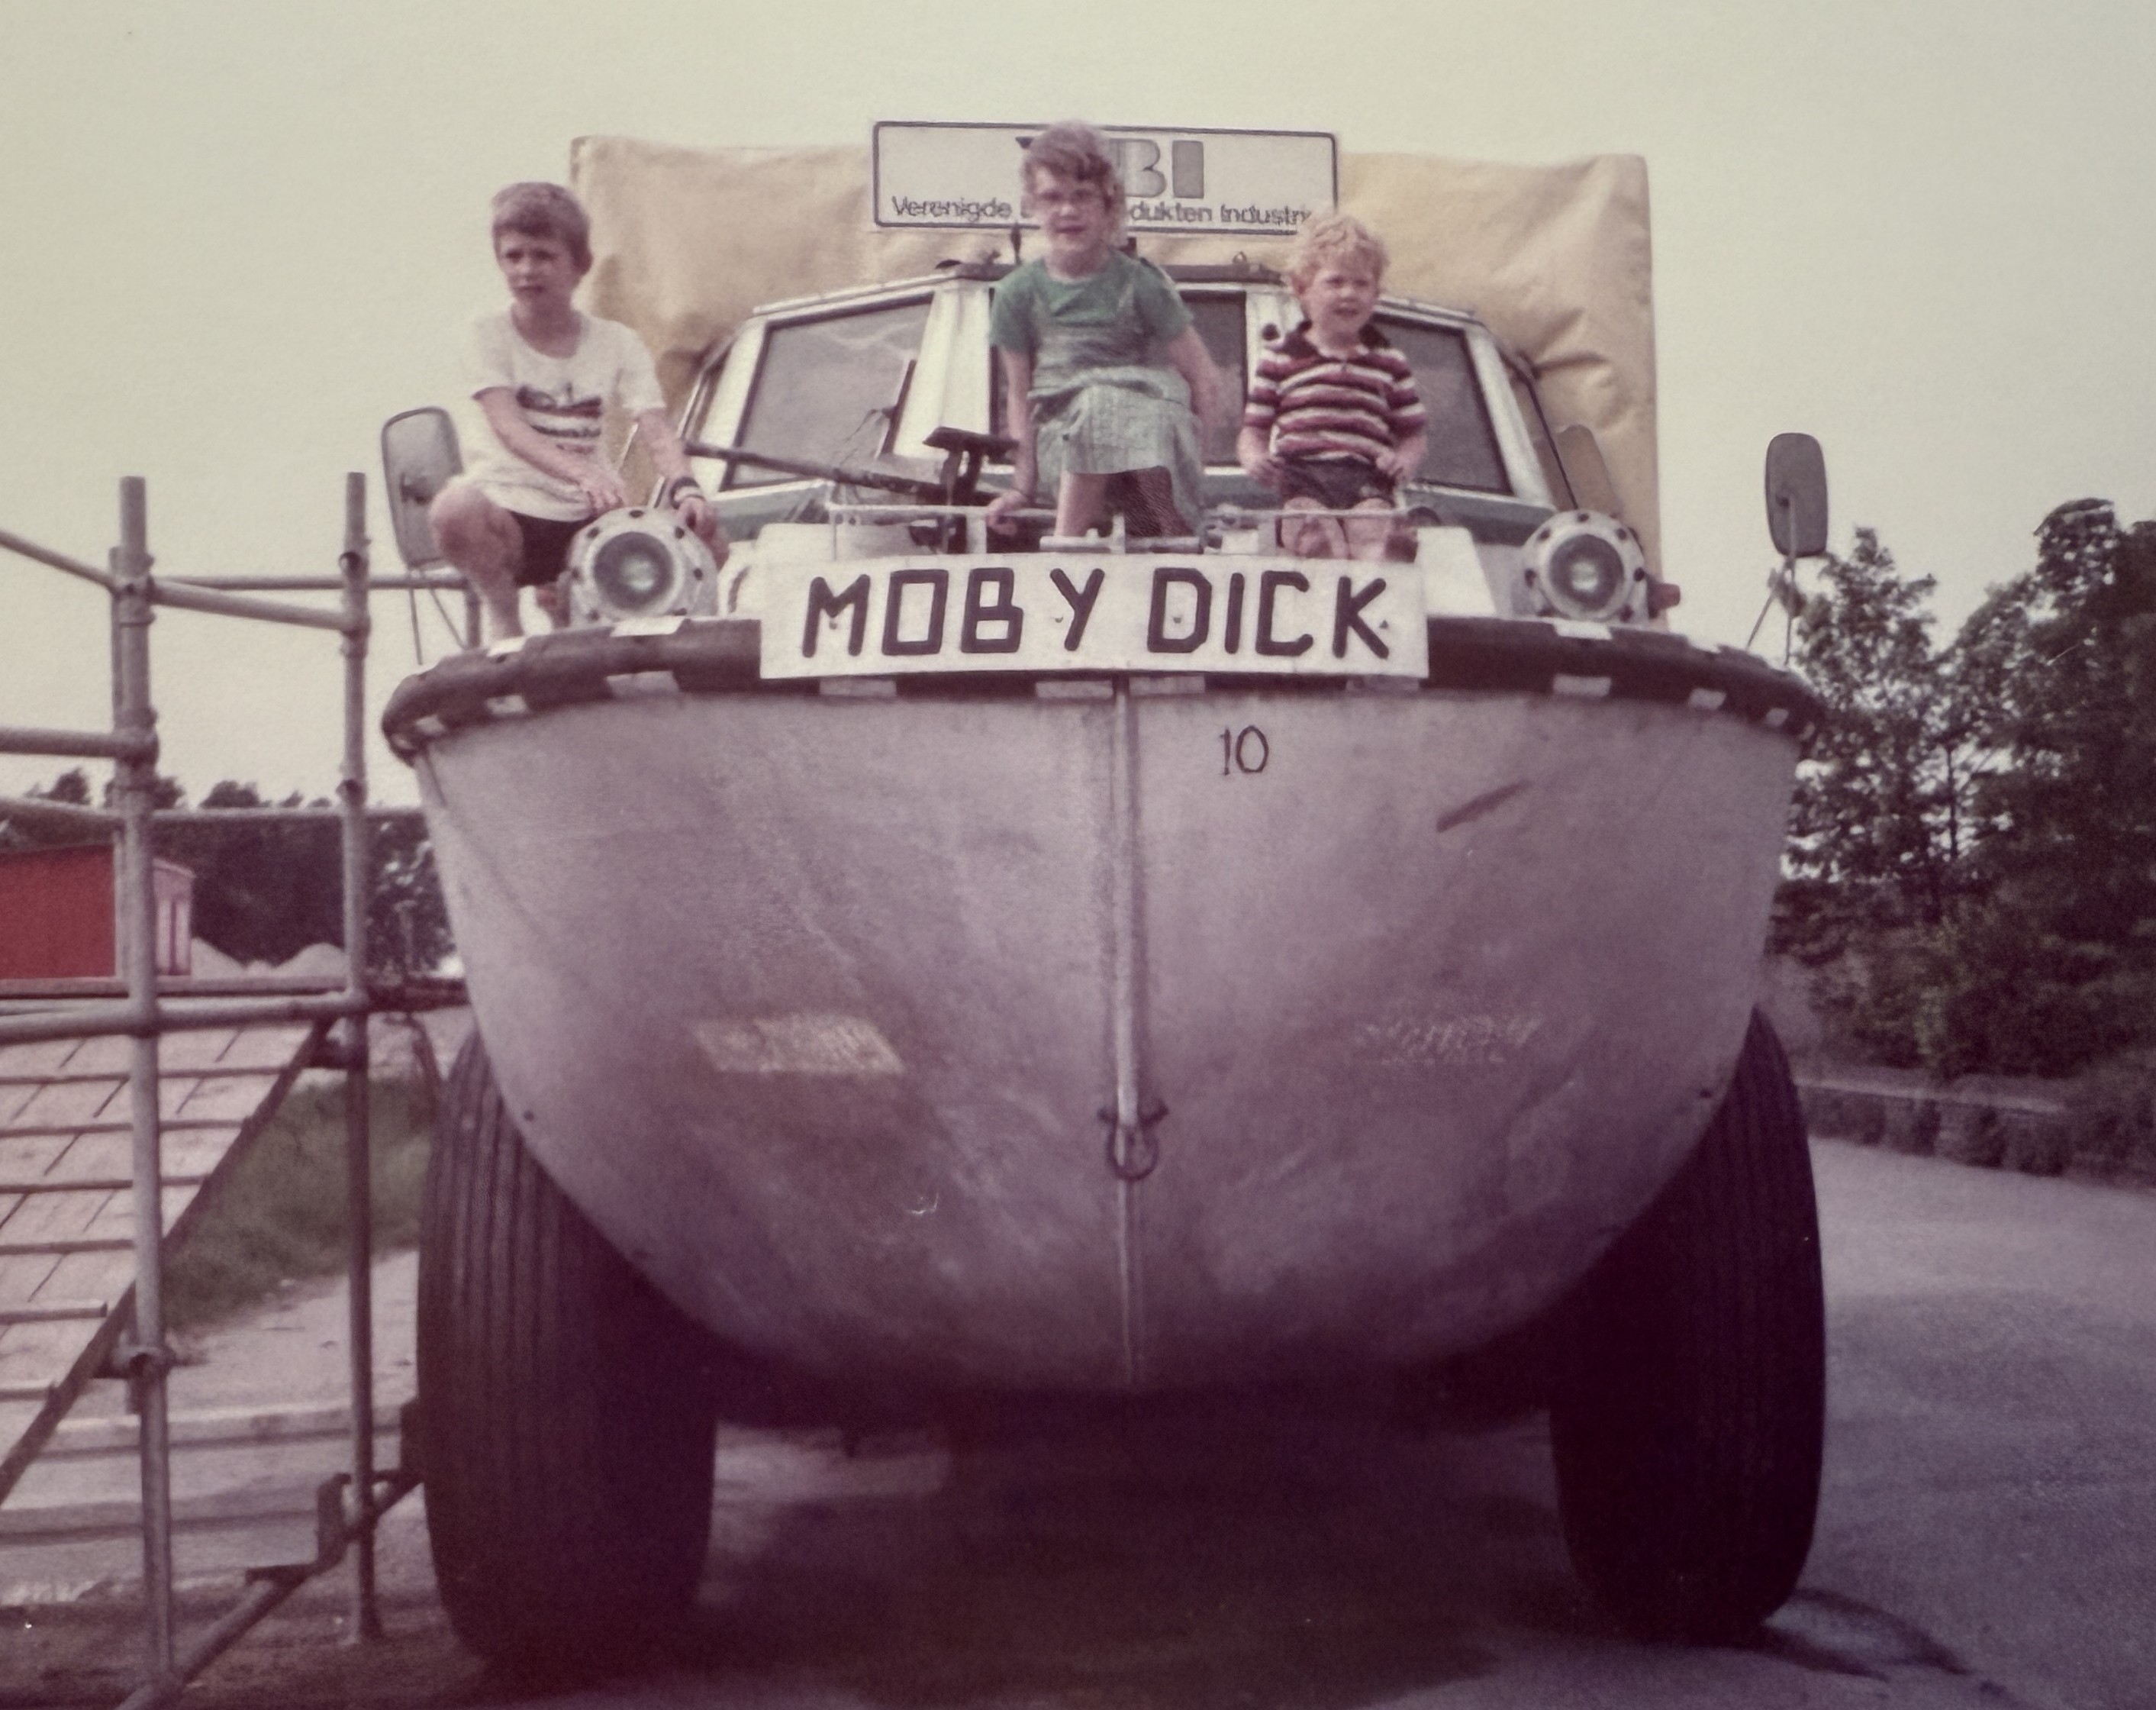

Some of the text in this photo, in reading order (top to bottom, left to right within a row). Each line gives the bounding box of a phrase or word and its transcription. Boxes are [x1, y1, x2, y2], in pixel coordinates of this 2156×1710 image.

[891, 195, 1013, 222] Verenigde
[802, 567, 1391, 660] MOBY DICK
[1220, 725, 1270, 776] 10
